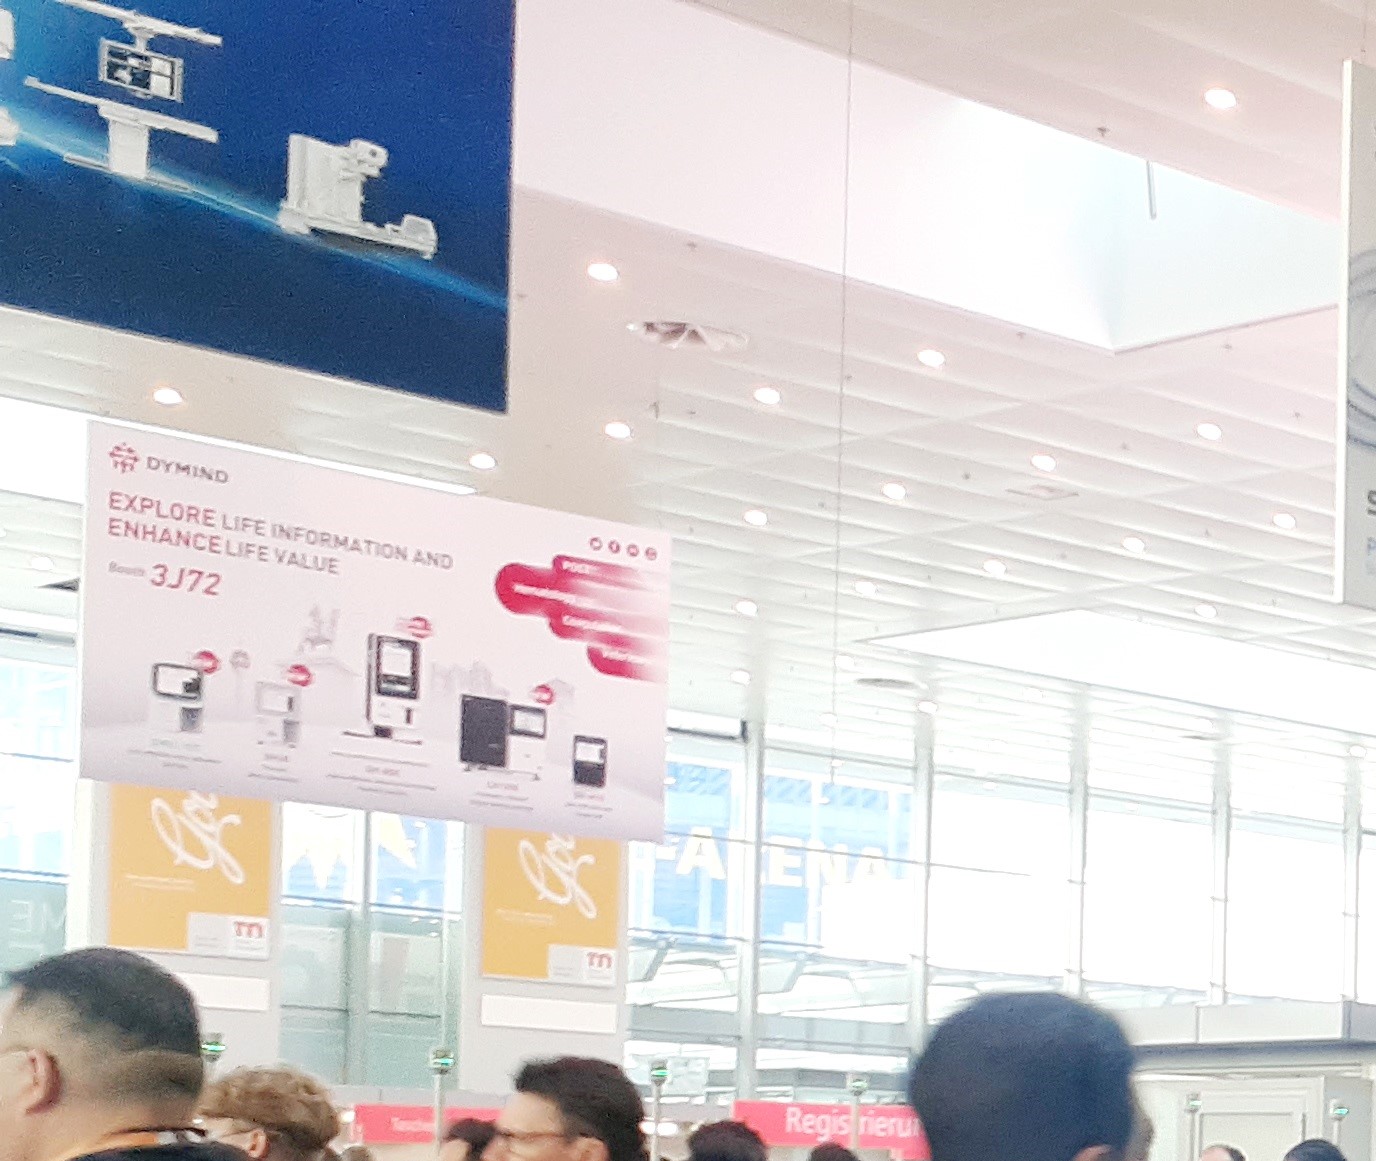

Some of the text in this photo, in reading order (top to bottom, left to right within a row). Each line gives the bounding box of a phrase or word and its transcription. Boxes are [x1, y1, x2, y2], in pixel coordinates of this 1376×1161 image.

[146, 456, 229, 484] DYMIND
[107, 517, 342, 576] ENHANCE LIFE VALUE
[108, 491, 455, 571] EXPLORE LIFE INFORMATION AND
[150, 563, 223, 597] 3J72
